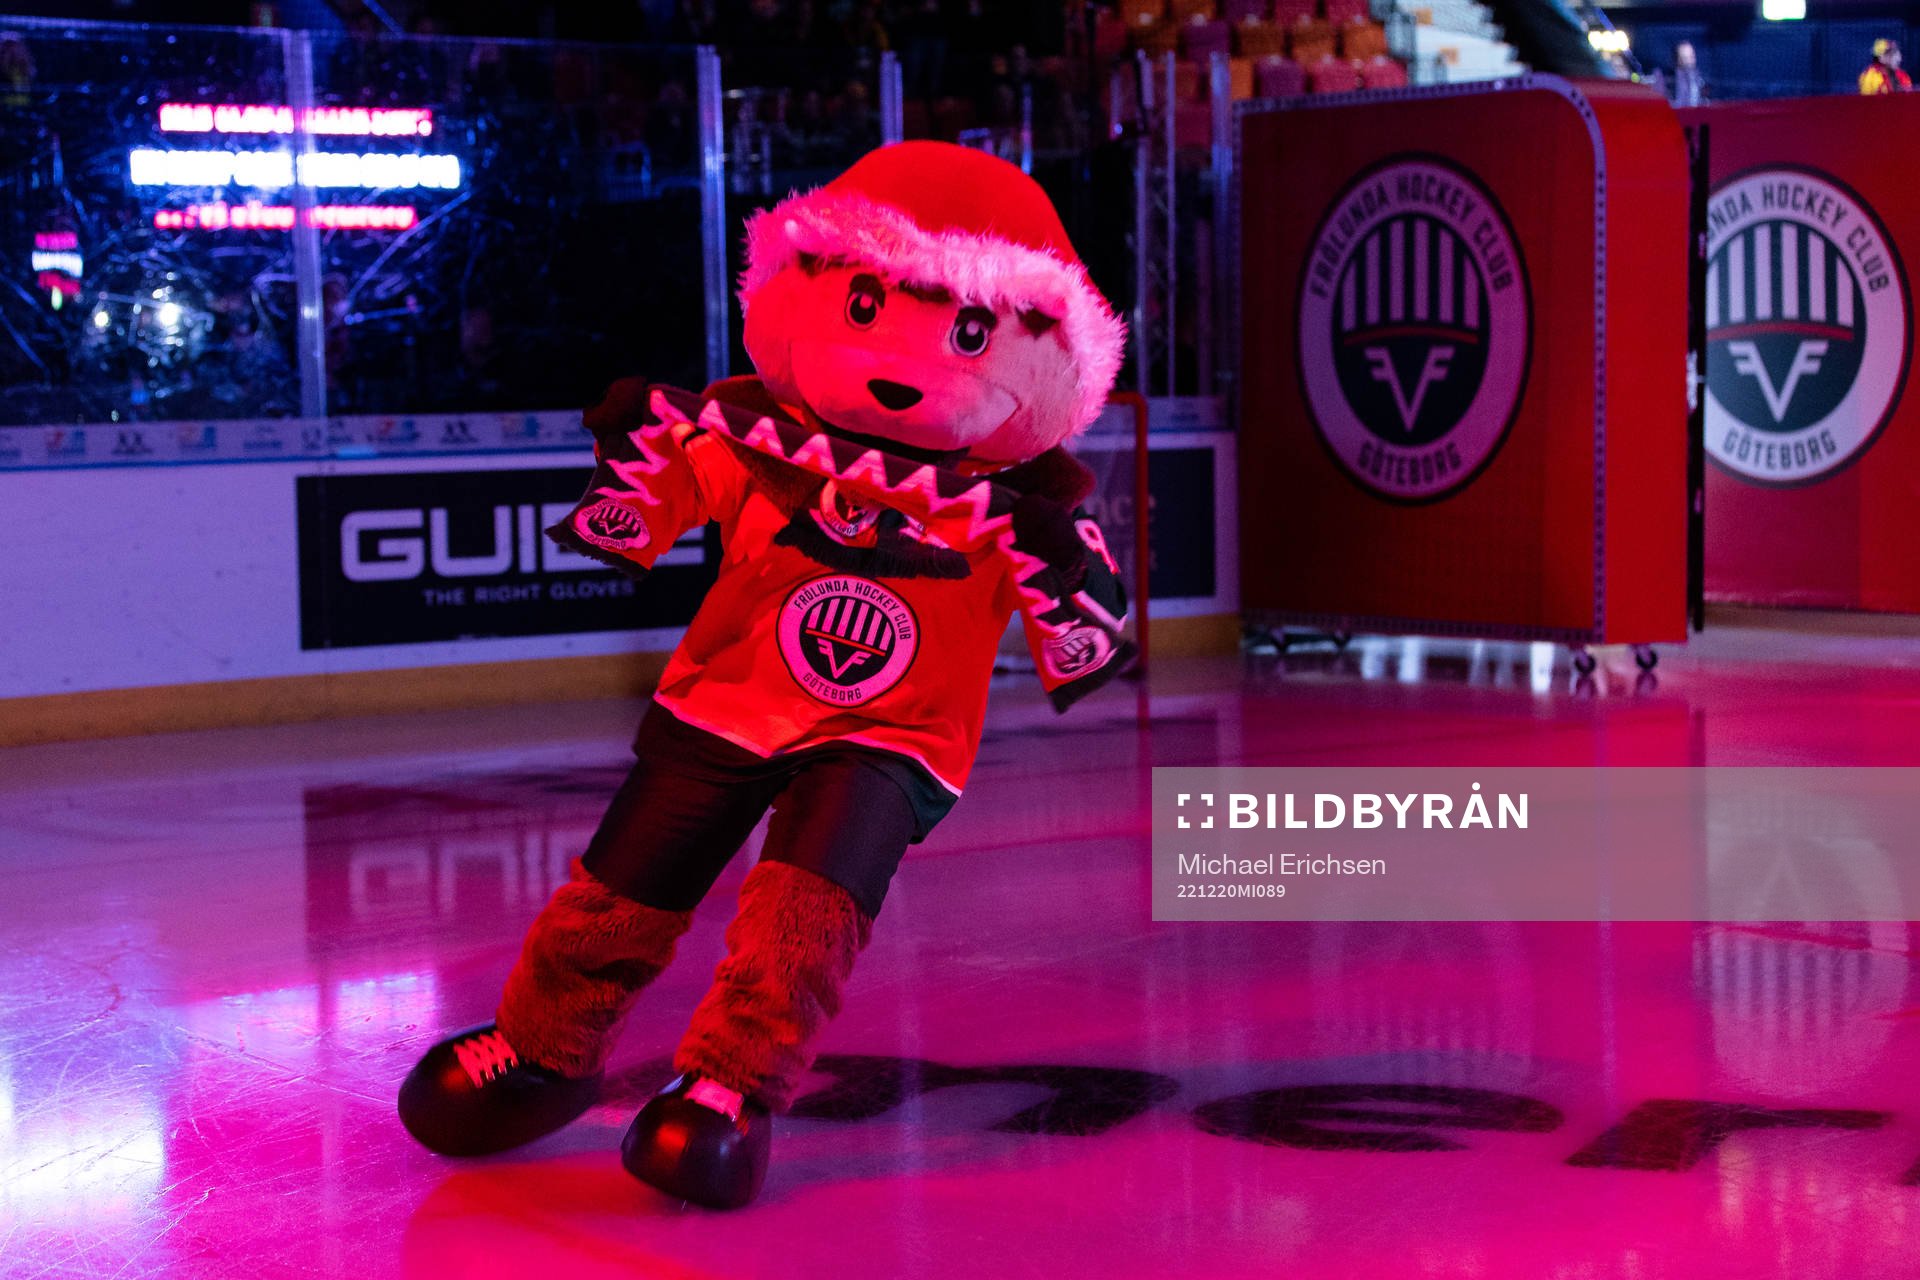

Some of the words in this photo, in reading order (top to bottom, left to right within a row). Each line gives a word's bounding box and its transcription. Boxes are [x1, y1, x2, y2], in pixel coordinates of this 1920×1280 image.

[1309, 181, 1389, 298] FRÖLUNDA
[1398, 173, 1476, 222] HOCKEY
[1473, 219, 1514, 291] CLUB
[1762, 182, 1848, 228] HOCKEY
[1847, 225, 1891, 293] CLUB
[1723, 427, 1837, 470] GÖTEBORG
[424, 588, 466, 607] THE
[474, 583, 543, 604] RIGHT
[550, 578, 635, 600] GLOVES
[794, 580, 849, 610] FRÖLUNDA
[855, 582, 900, 613] HOCKEY
[894, 613, 911, 640] CLUB
[803, 672, 862, 702] GÖTEBORG
